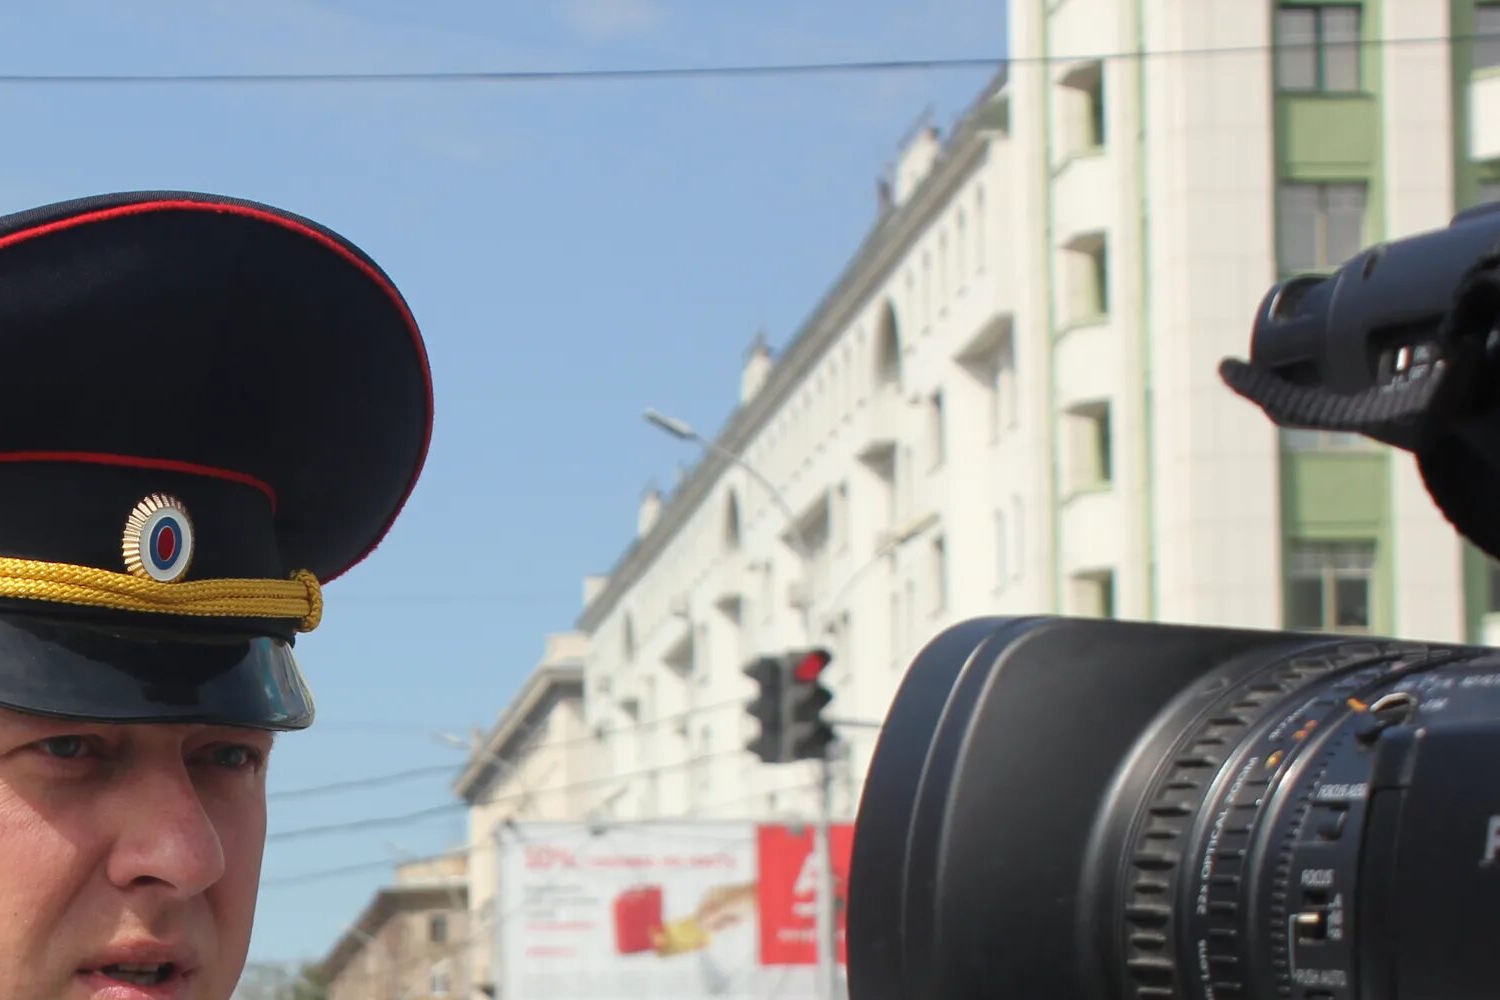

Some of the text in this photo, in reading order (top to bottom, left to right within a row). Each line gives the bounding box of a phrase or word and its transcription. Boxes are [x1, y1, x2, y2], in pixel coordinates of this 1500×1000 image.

[1201, 811, 1228, 880] OPTICAL
[1226, 757, 1259, 803] ZOOM
[1300, 867, 1335, 887] FOCUS
